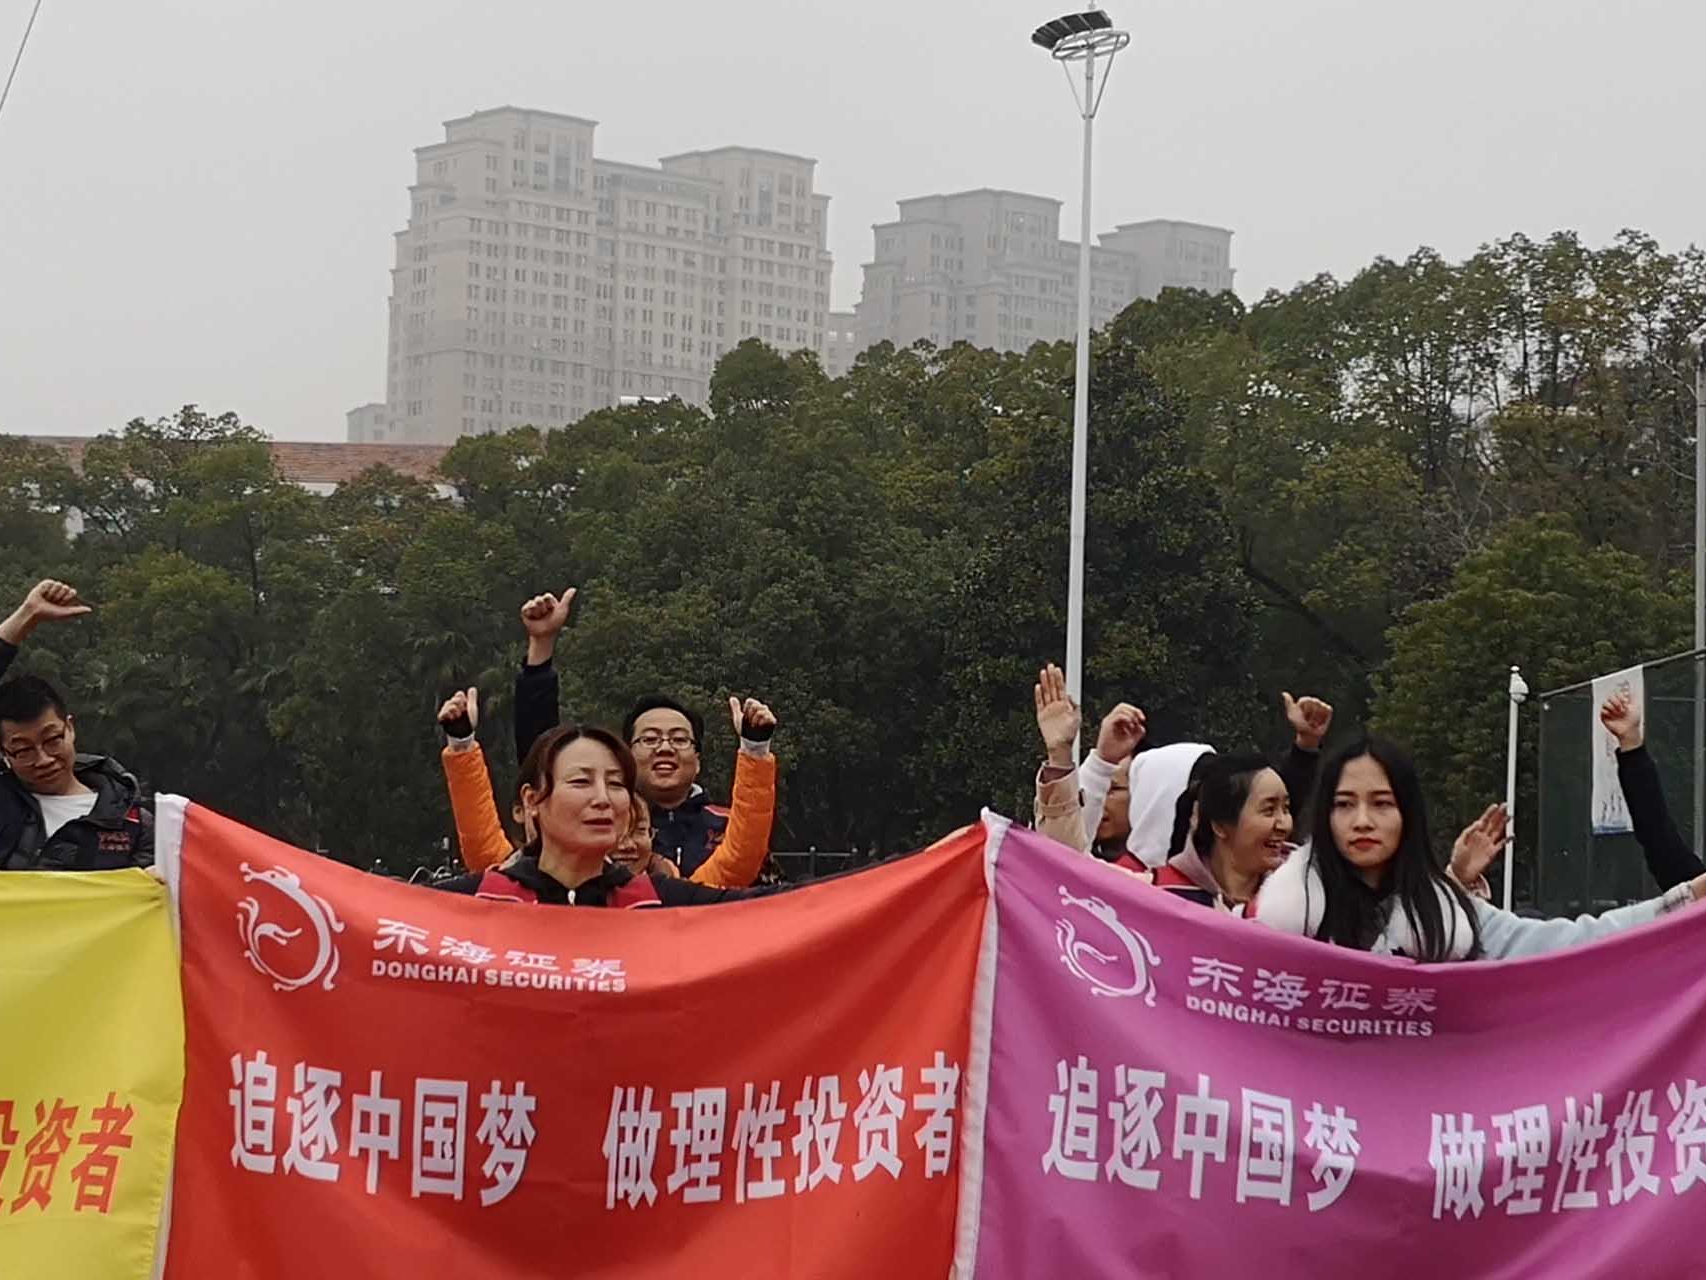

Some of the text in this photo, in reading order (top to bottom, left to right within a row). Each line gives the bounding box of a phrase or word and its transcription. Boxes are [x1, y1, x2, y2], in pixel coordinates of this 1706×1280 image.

[372, 959, 627, 994] DONGHAI SECURITIES
[373, 918, 627, 978] 东海证券
[1187, 955, 1437, 1016] 东海证券
[1186, 995, 1433, 1038] DONGHAI SECURITIES
[229, 1050, 961, 1210] 追逐中国梦 做理性投资者
[1042, 1055, 1362, 1213] 追逐中国梦
